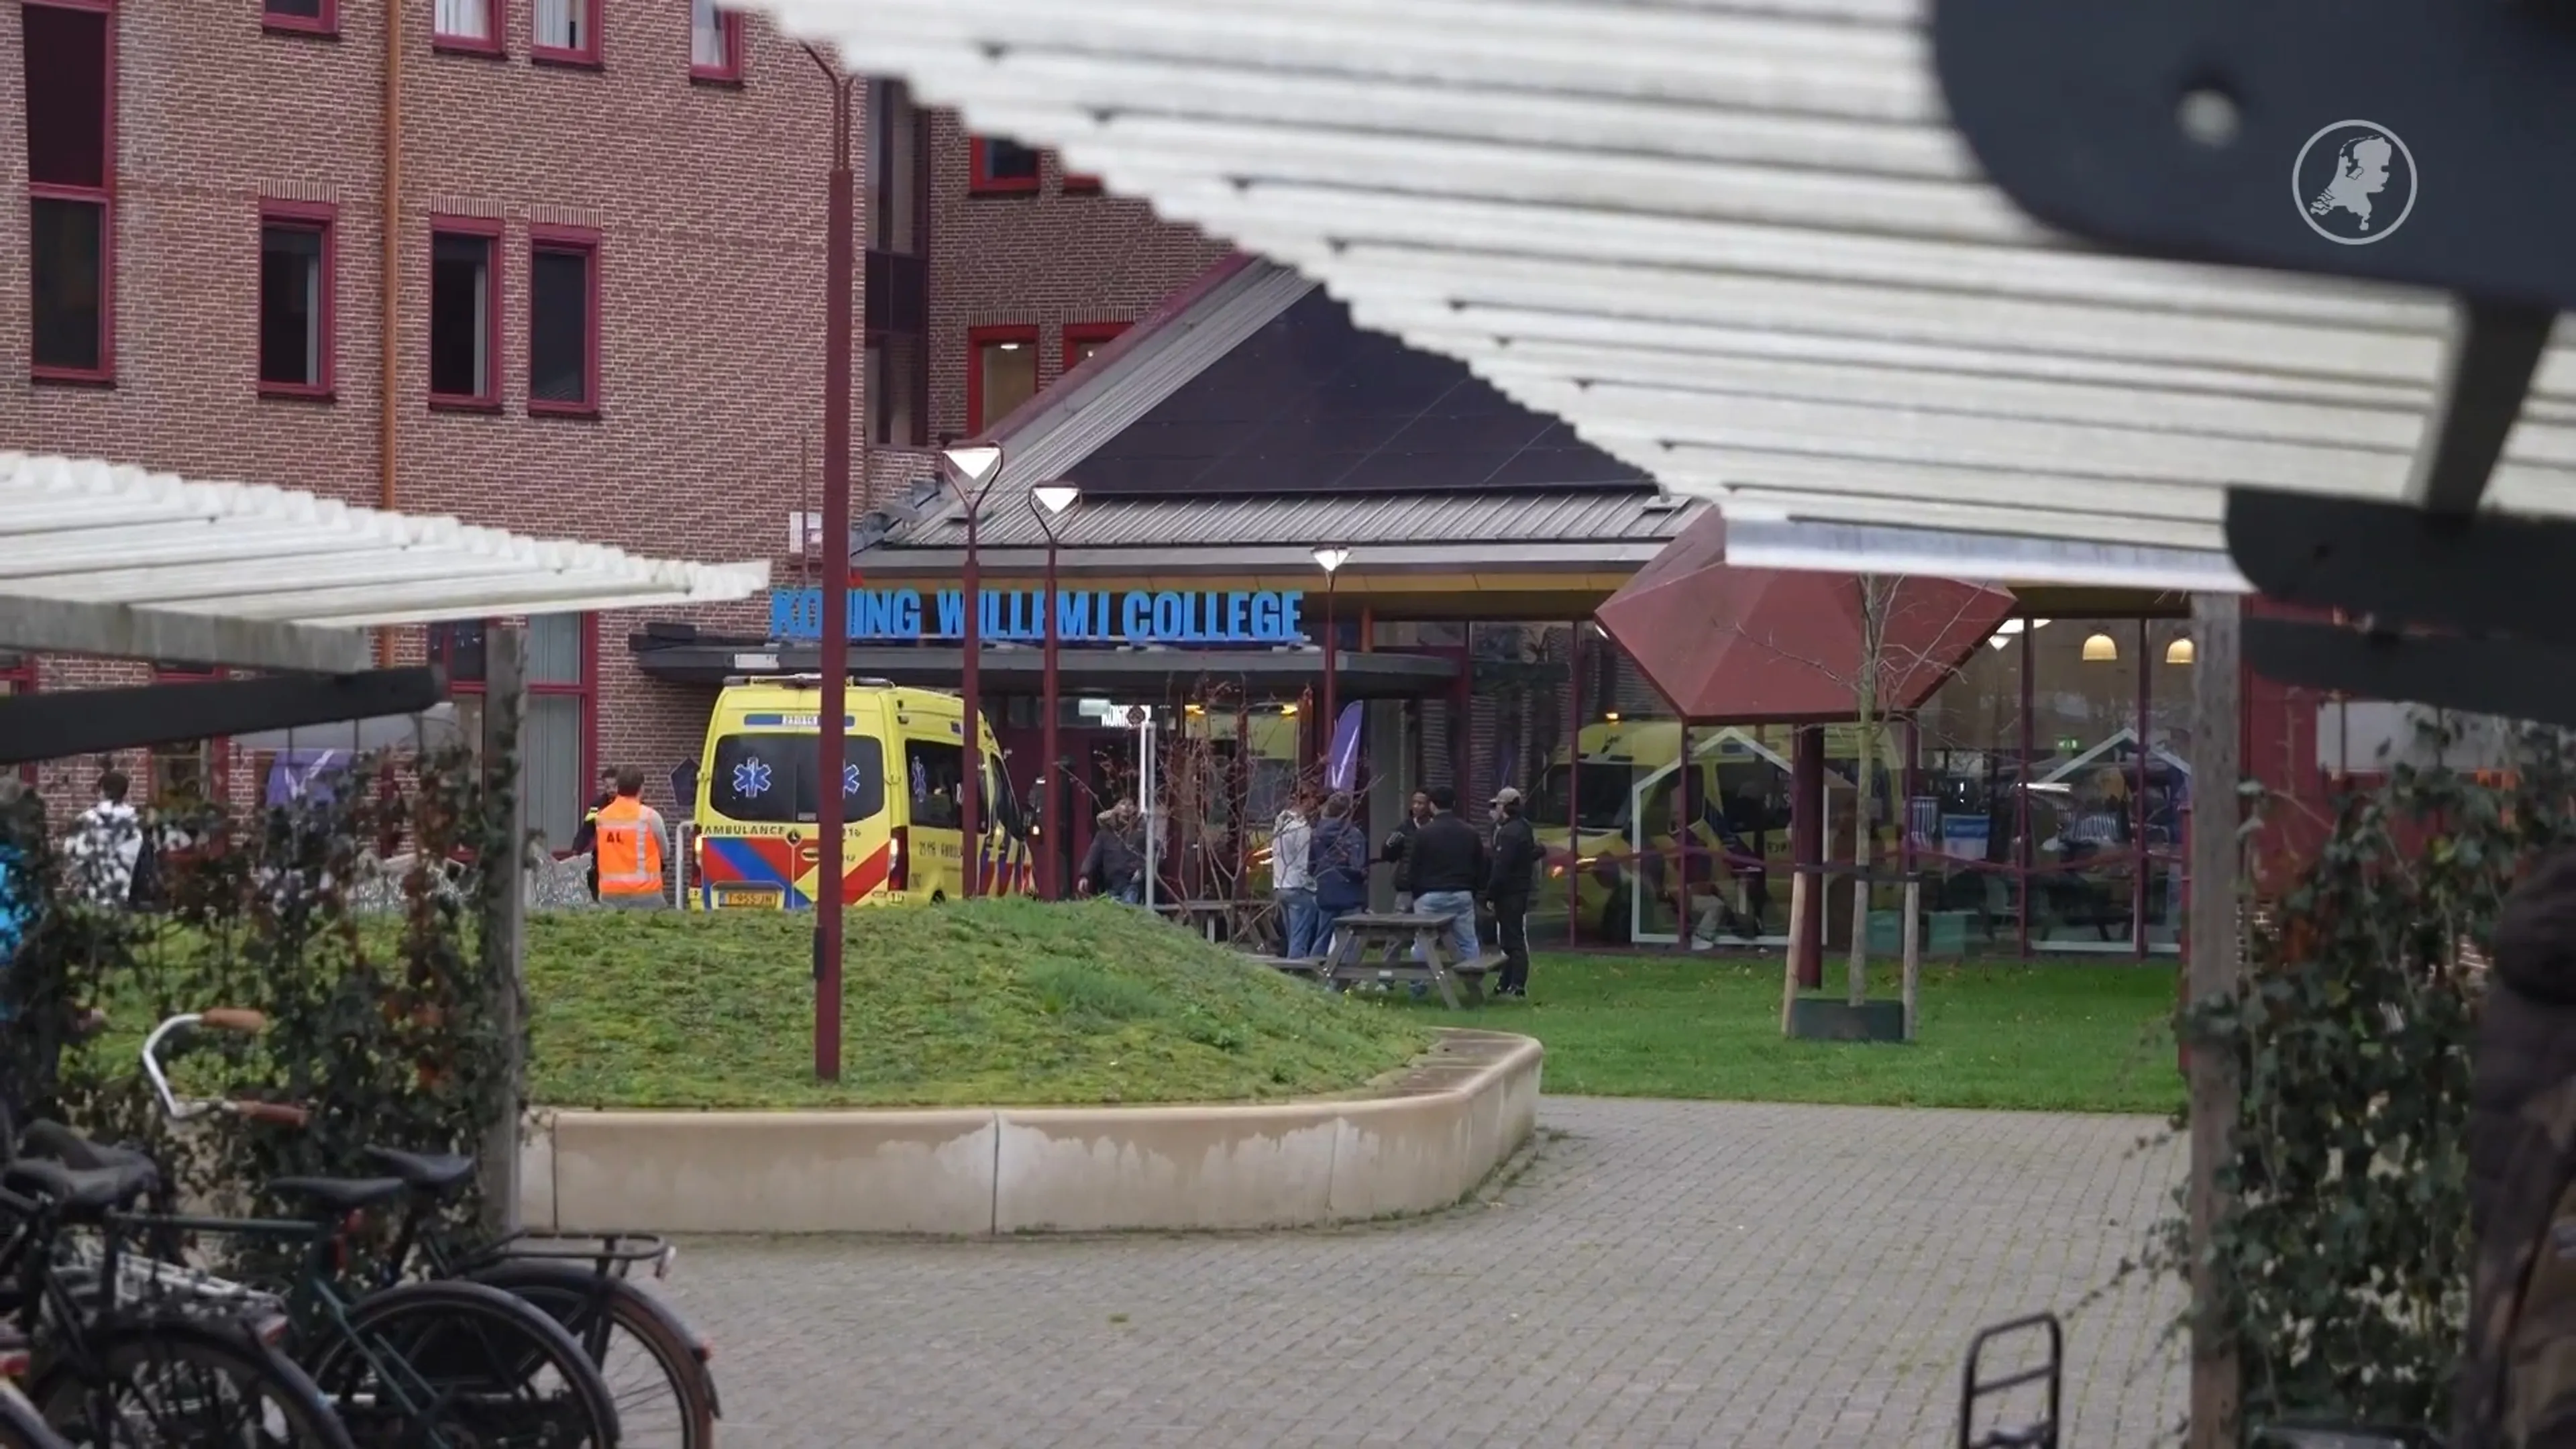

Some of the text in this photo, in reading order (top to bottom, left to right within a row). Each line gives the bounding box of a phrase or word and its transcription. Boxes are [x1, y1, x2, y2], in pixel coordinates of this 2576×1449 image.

[771, 588, 922, 639] KOING
[1122, 589, 1304, 641] COLLEGE
[704, 825, 785, 835] AMBULANCE
